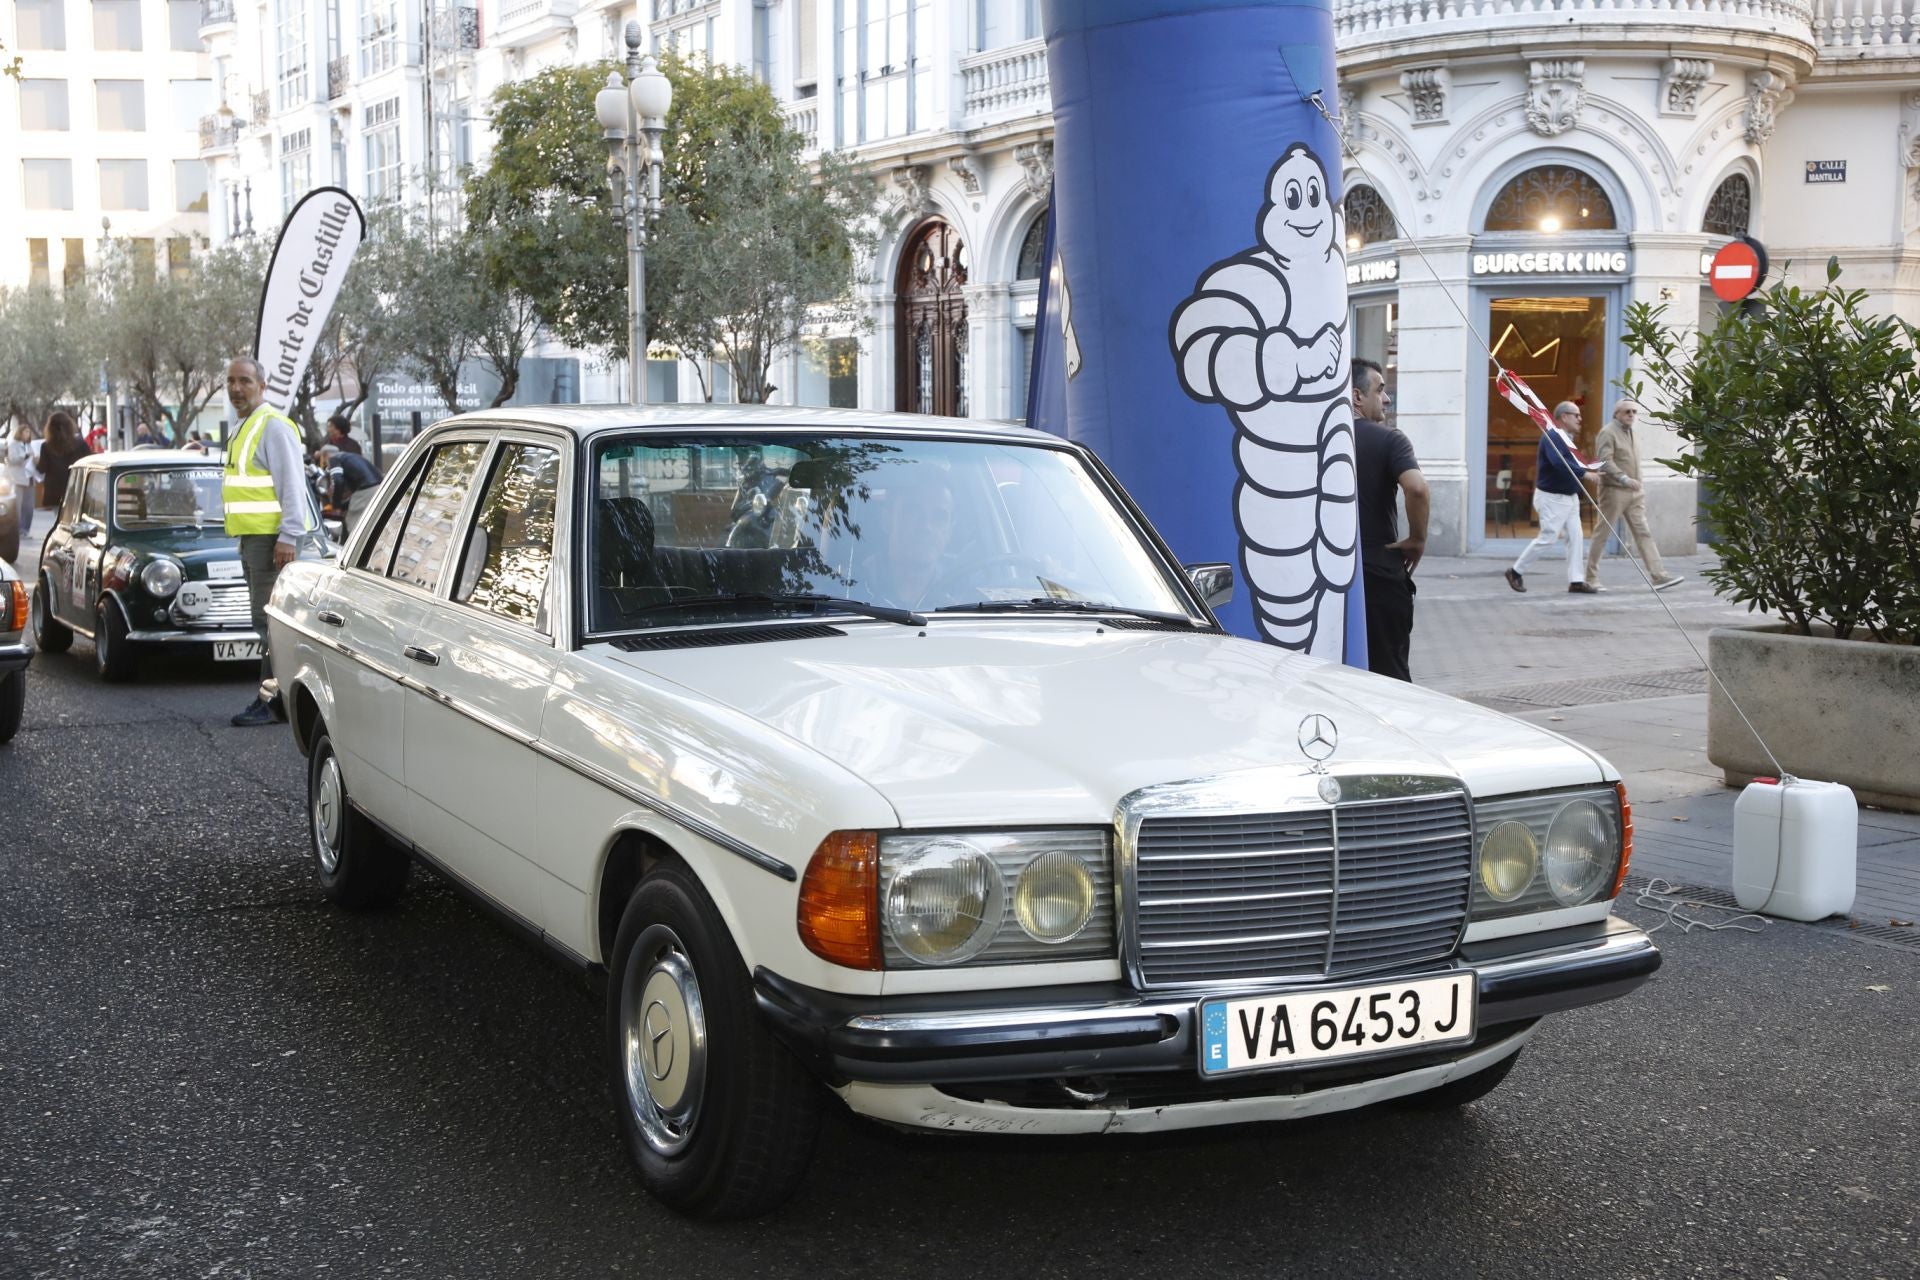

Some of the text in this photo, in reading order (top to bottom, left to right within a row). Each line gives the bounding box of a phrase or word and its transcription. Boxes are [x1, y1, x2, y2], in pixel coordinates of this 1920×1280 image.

[1820, 161, 1845, 170] CALLE
[1809, 173, 1843, 182] MANTILLA
[299, 201, 352, 298] Castilla
[1361, 260, 1397, 281] KING
[1473, 252, 1627, 274] BURGER KING
[286, 300, 314, 328] de
[265, 329, 304, 398] Norte
[377, 383, 405, 394] Todo
[408, 386, 422, 394] es
[377, 396, 421, 407] cuando
[1238, 983, 1458, 1059] VA 6453 J
[1211, 1043, 1222, 1059] E
